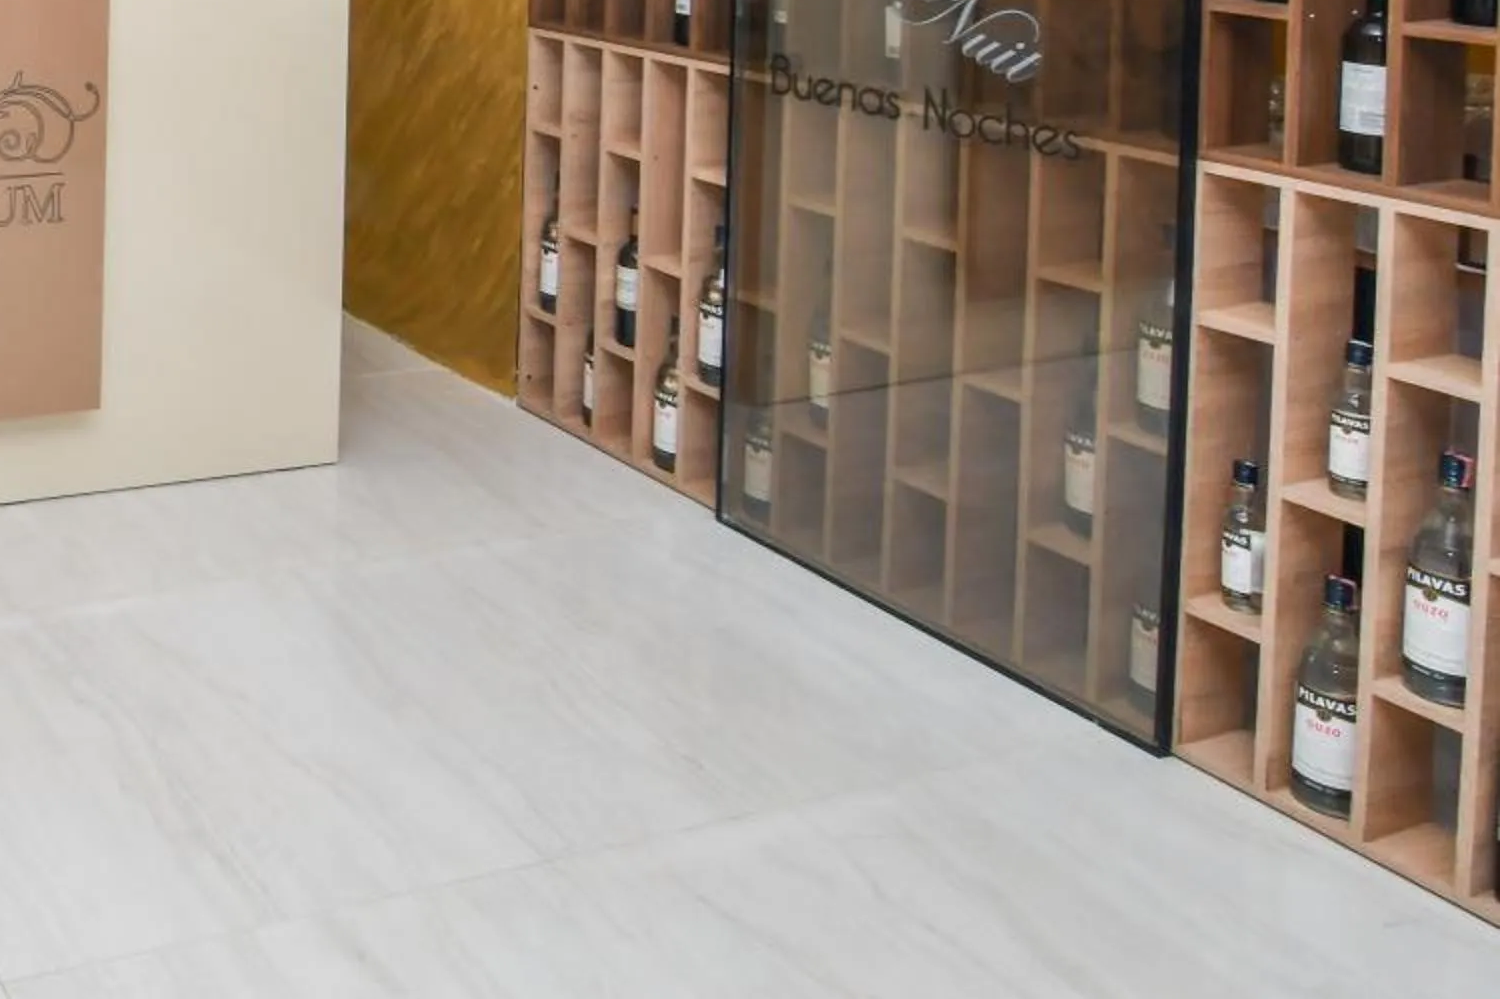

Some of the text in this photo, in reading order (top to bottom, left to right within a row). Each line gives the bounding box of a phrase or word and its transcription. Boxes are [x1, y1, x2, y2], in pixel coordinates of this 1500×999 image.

[770, 54, 1083, 160] Buenas Noches
[1299, 685, 1357, 716] PILAVAS
